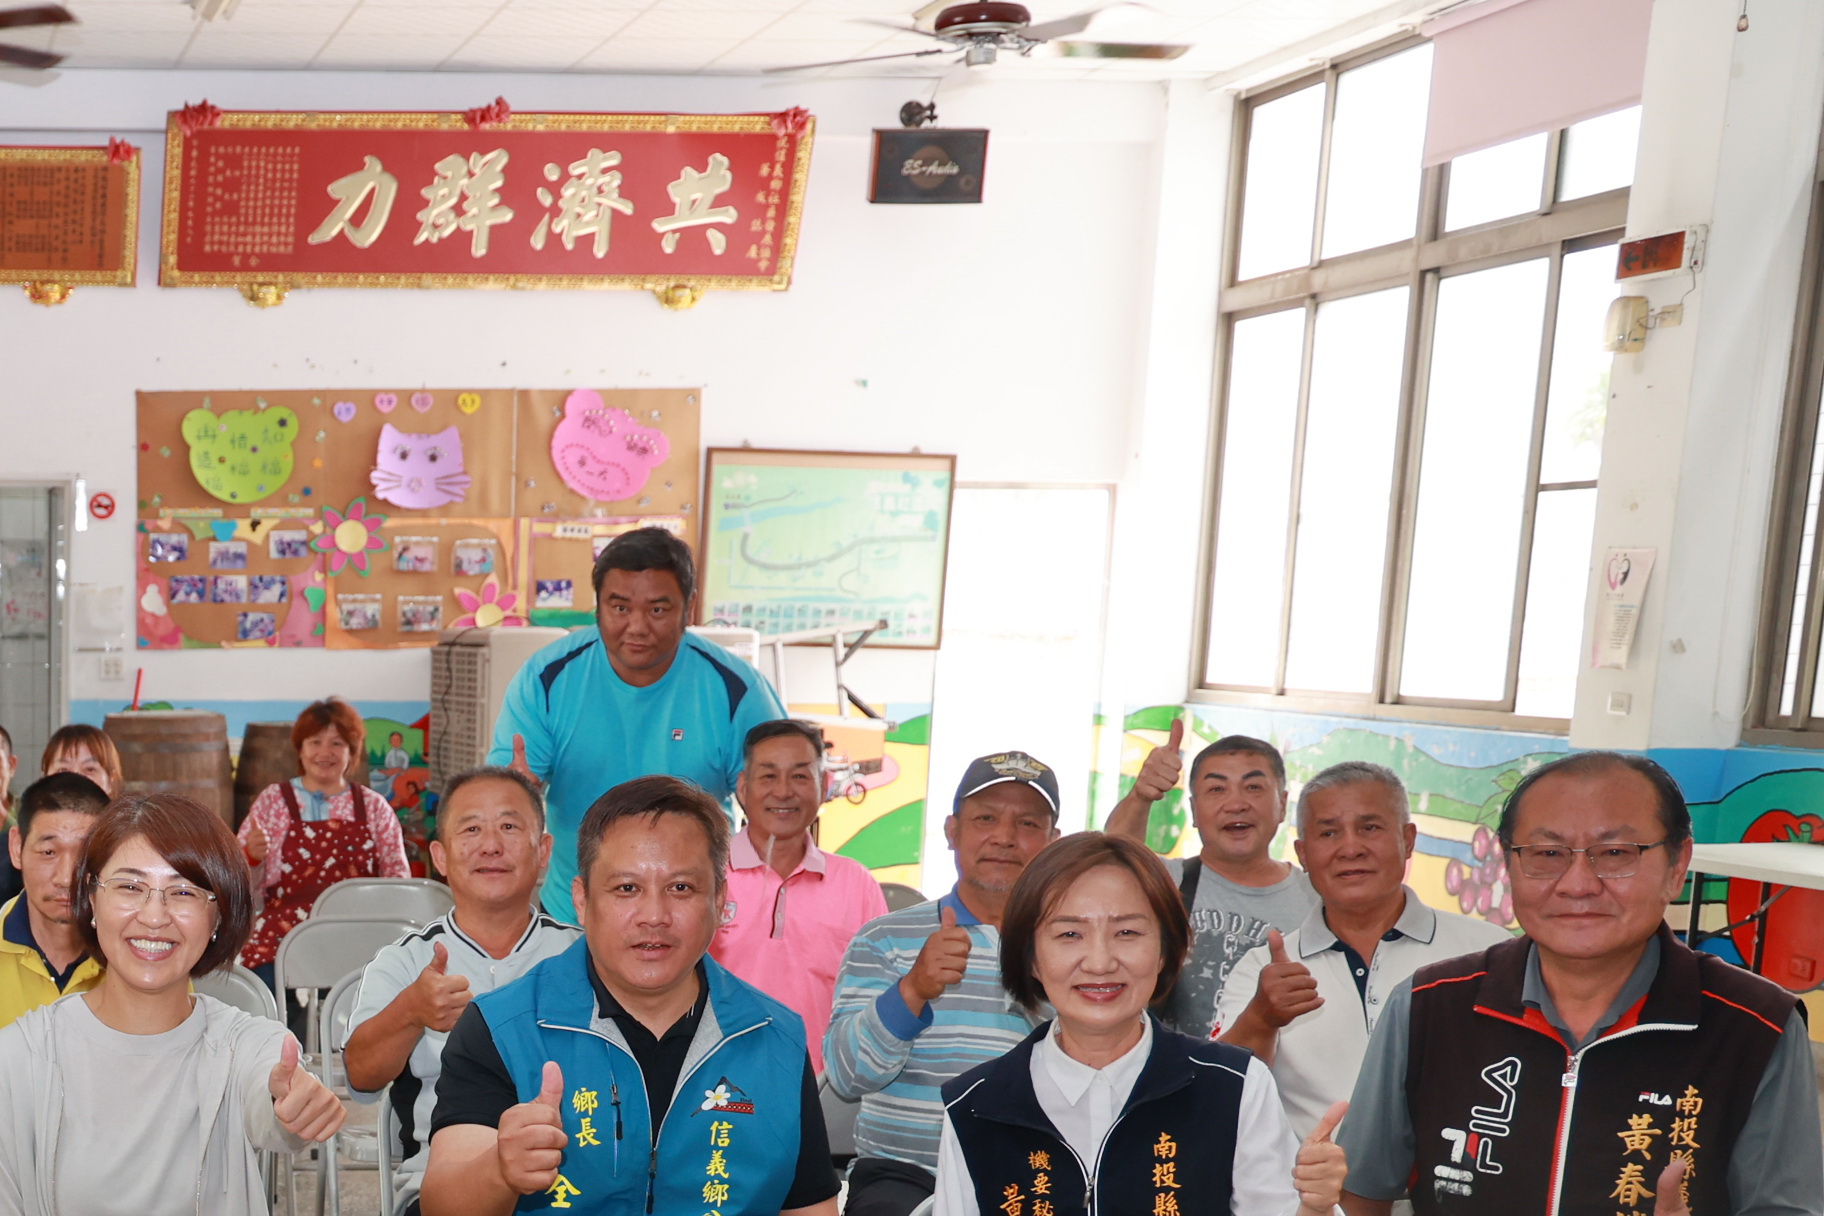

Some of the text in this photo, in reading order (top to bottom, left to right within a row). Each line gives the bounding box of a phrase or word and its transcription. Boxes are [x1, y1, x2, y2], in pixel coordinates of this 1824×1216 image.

[901, 156, 960, 178] ES-Audio
[307, 147, 740, 258] 共濟群力
[572, 1087, 601, 1148] 鄉長
[1469, 1056, 1522, 1175] FILA
[1637, 1090, 1673, 1106] FILA
